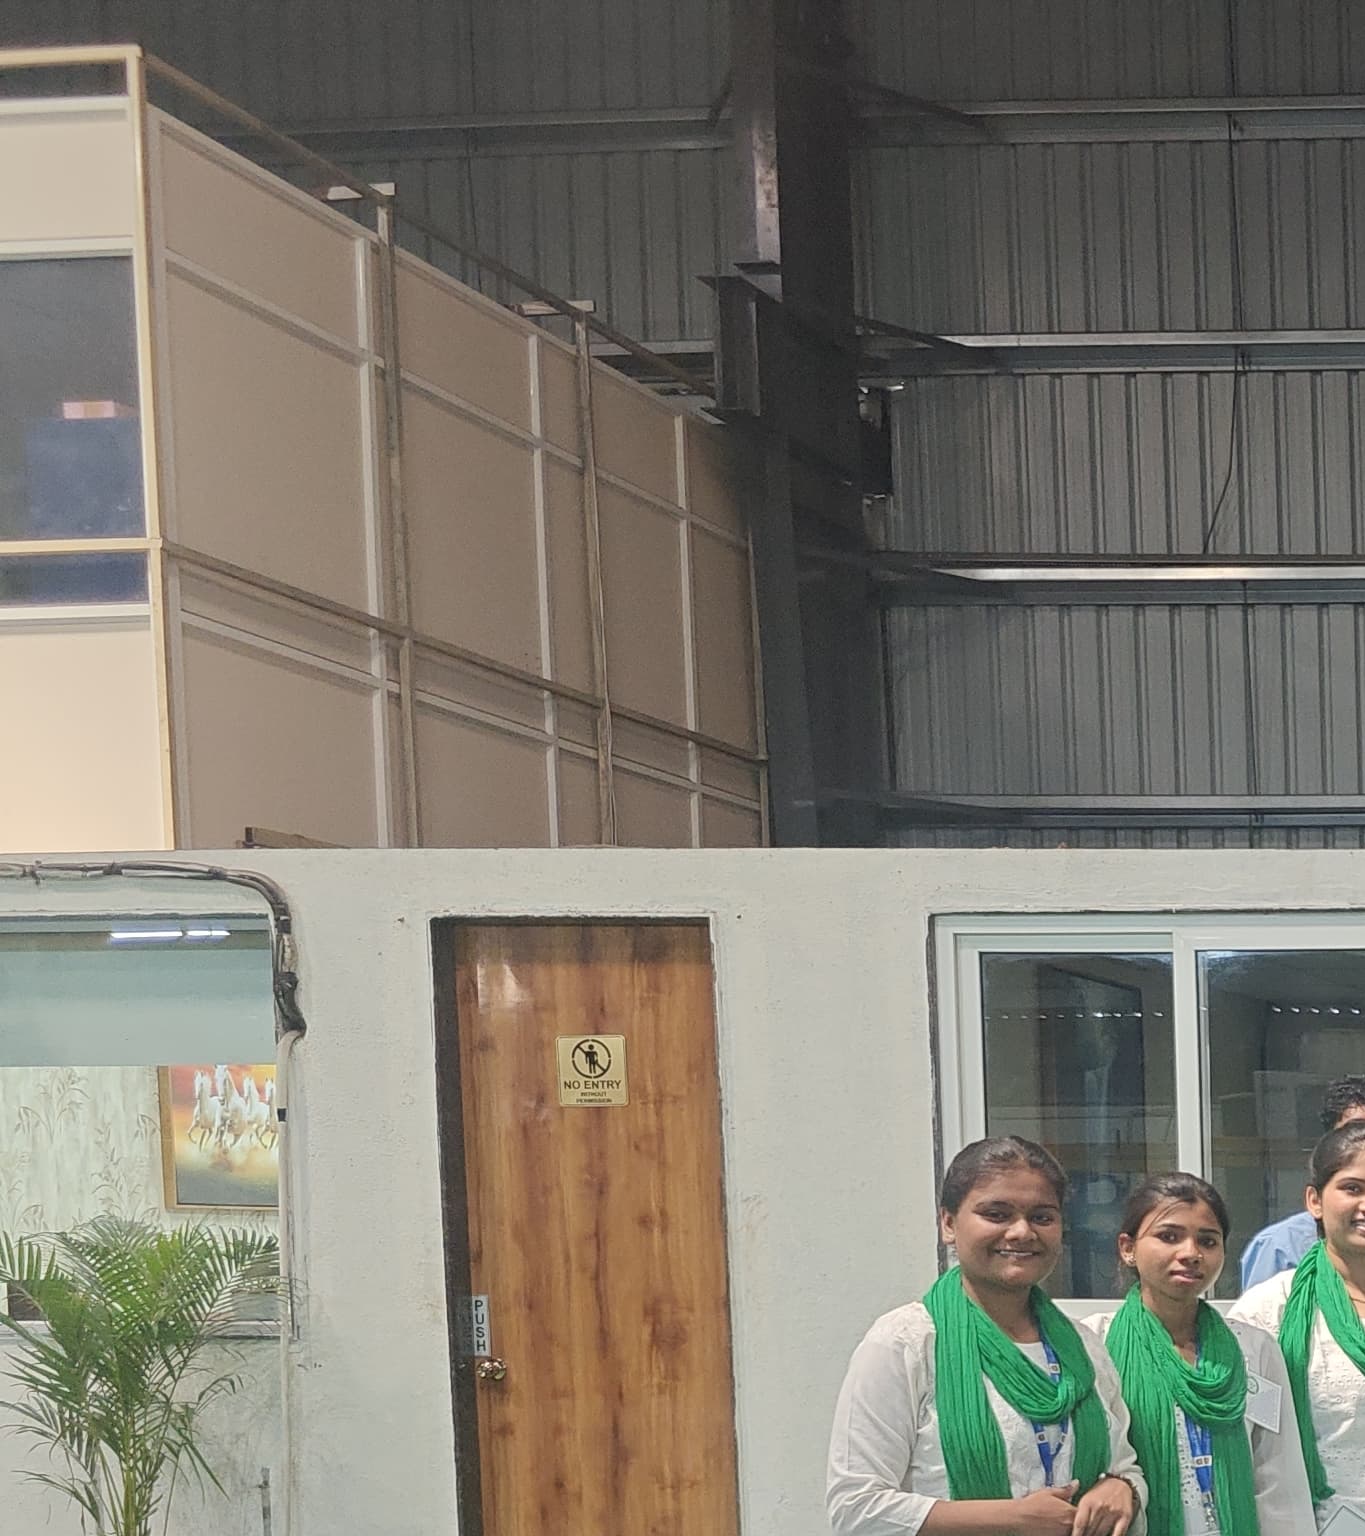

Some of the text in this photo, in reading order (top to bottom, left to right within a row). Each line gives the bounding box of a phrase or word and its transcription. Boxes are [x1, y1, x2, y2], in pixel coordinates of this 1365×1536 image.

[564, 1080, 621, 1089] NO ENTRY
[474, 1299, 486, 1352] PUSH
